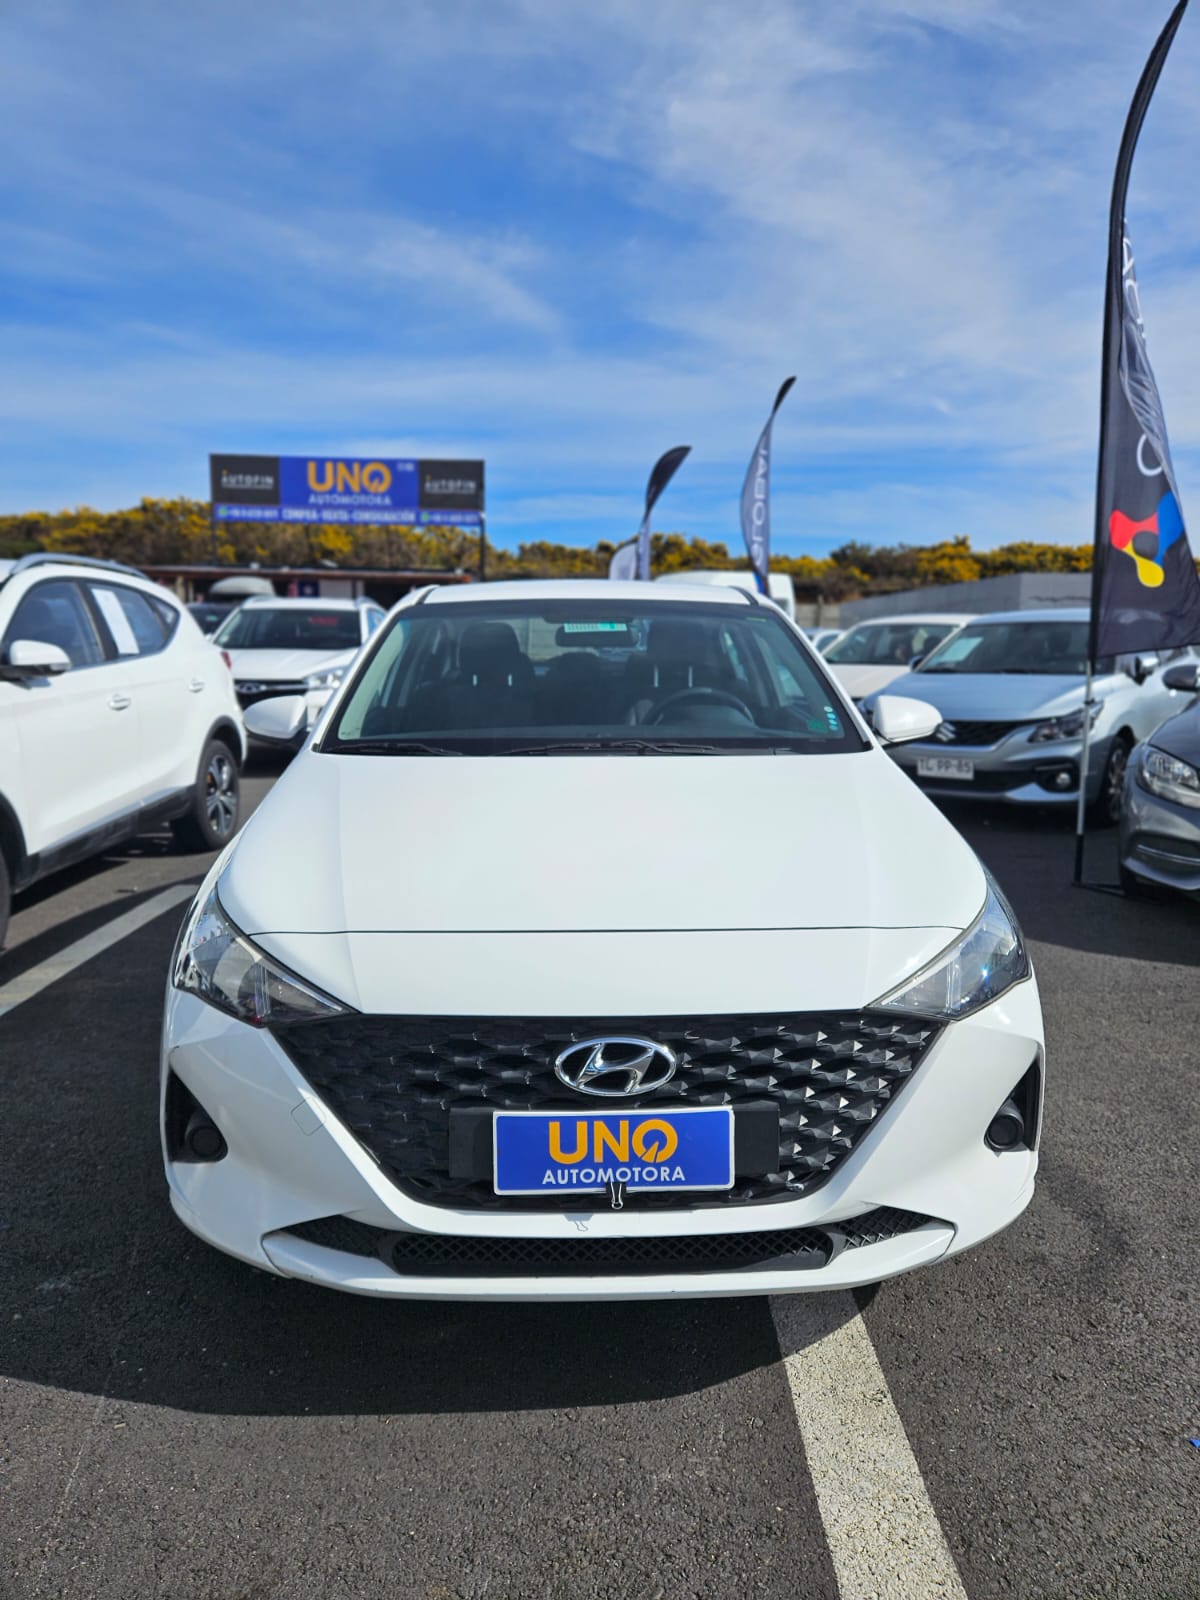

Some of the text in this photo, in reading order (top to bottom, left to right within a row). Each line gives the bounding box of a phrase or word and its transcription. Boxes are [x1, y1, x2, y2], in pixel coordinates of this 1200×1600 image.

[221, 472, 274, 485] AUTOFIN
[307, 461, 392, 493] UNO
[425, 478, 476, 490] AUTOFIN
[308, 494, 392, 505] AUTOMOTORA
[548, 1119, 678, 1164] UNO
[542, 1166, 685, 1185] AUTOMOTORA
